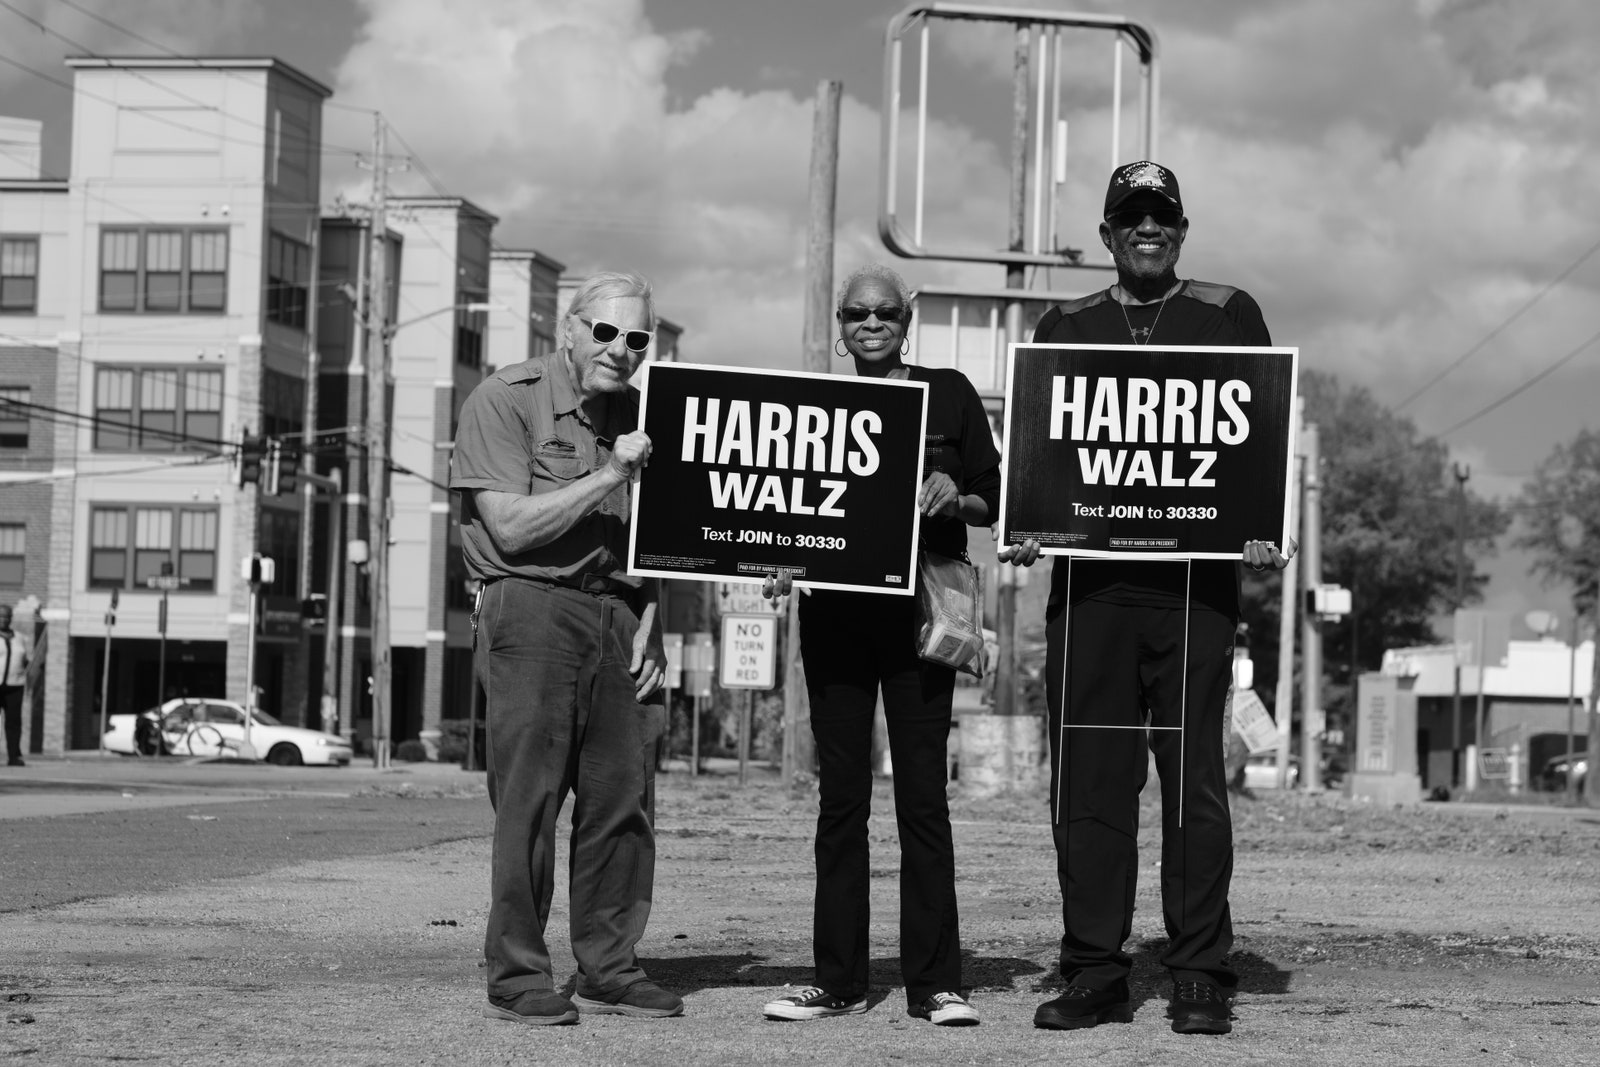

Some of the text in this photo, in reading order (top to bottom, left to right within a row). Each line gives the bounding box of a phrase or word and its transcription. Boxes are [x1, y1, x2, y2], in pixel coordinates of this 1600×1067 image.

[1050, 375, 1251, 445] HARRIS
[681, 396, 882, 477] HARRIS
[1077, 448, 1218, 487] WALZ
[708, 470, 848, 517] WALZ
[1072, 503, 1218, 520] Text JOIN to 30330
[701, 527, 847, 551] Text JOIN to 30330
[736, 623, 763, 637] NO
[734, 640, 765, 652] TURN
[739, 655, 758, 666] ON
[735, 668, 760, 680] RED
